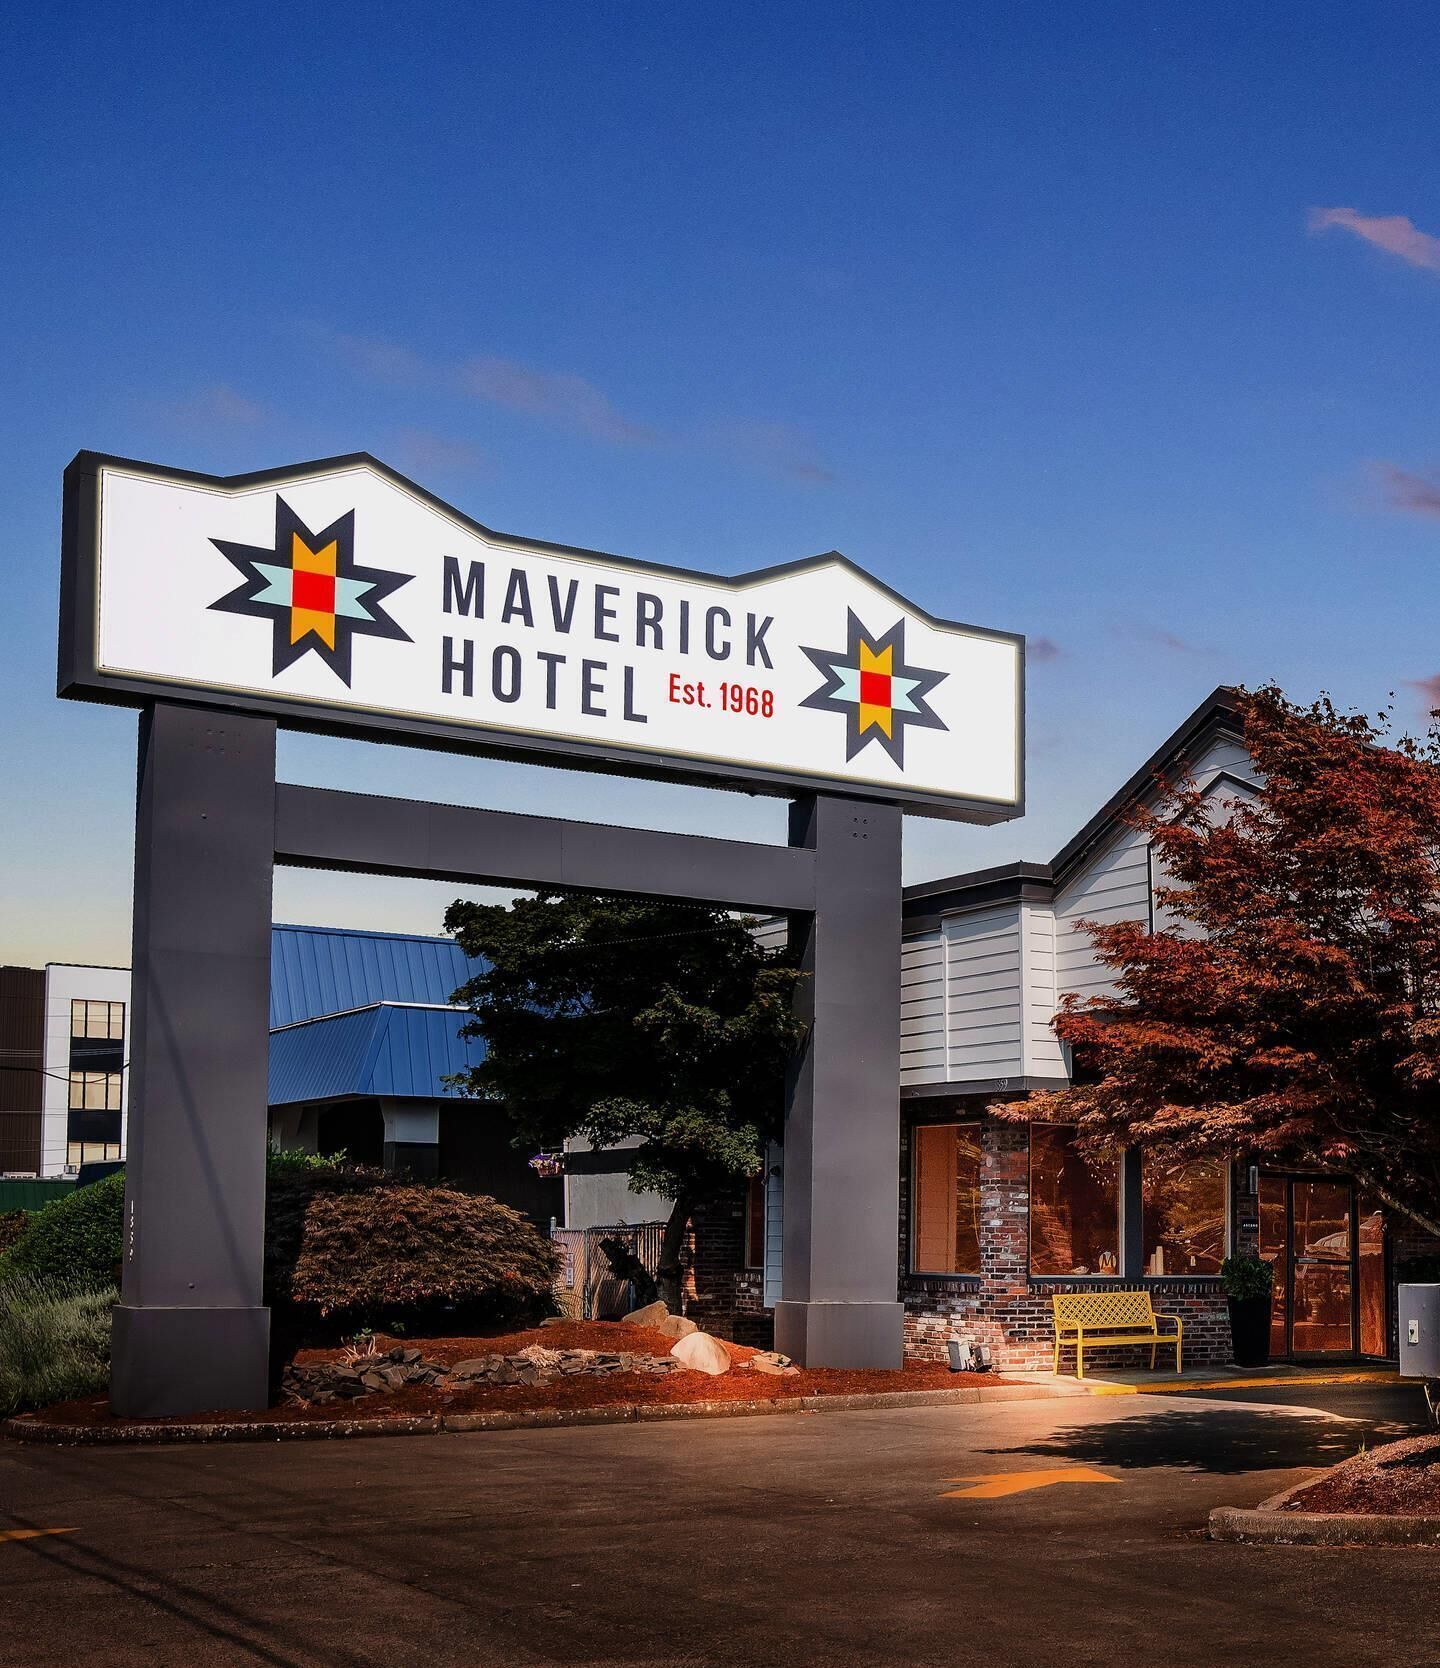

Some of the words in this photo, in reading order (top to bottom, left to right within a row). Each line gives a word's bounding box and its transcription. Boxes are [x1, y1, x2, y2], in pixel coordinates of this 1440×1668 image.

[442, 555, 775, 670] MAVERICK
[441, 635, 649, 724] HOTEL
[668, 672, 712, 709] Est.
[719, 682, 775, 719] 1968
